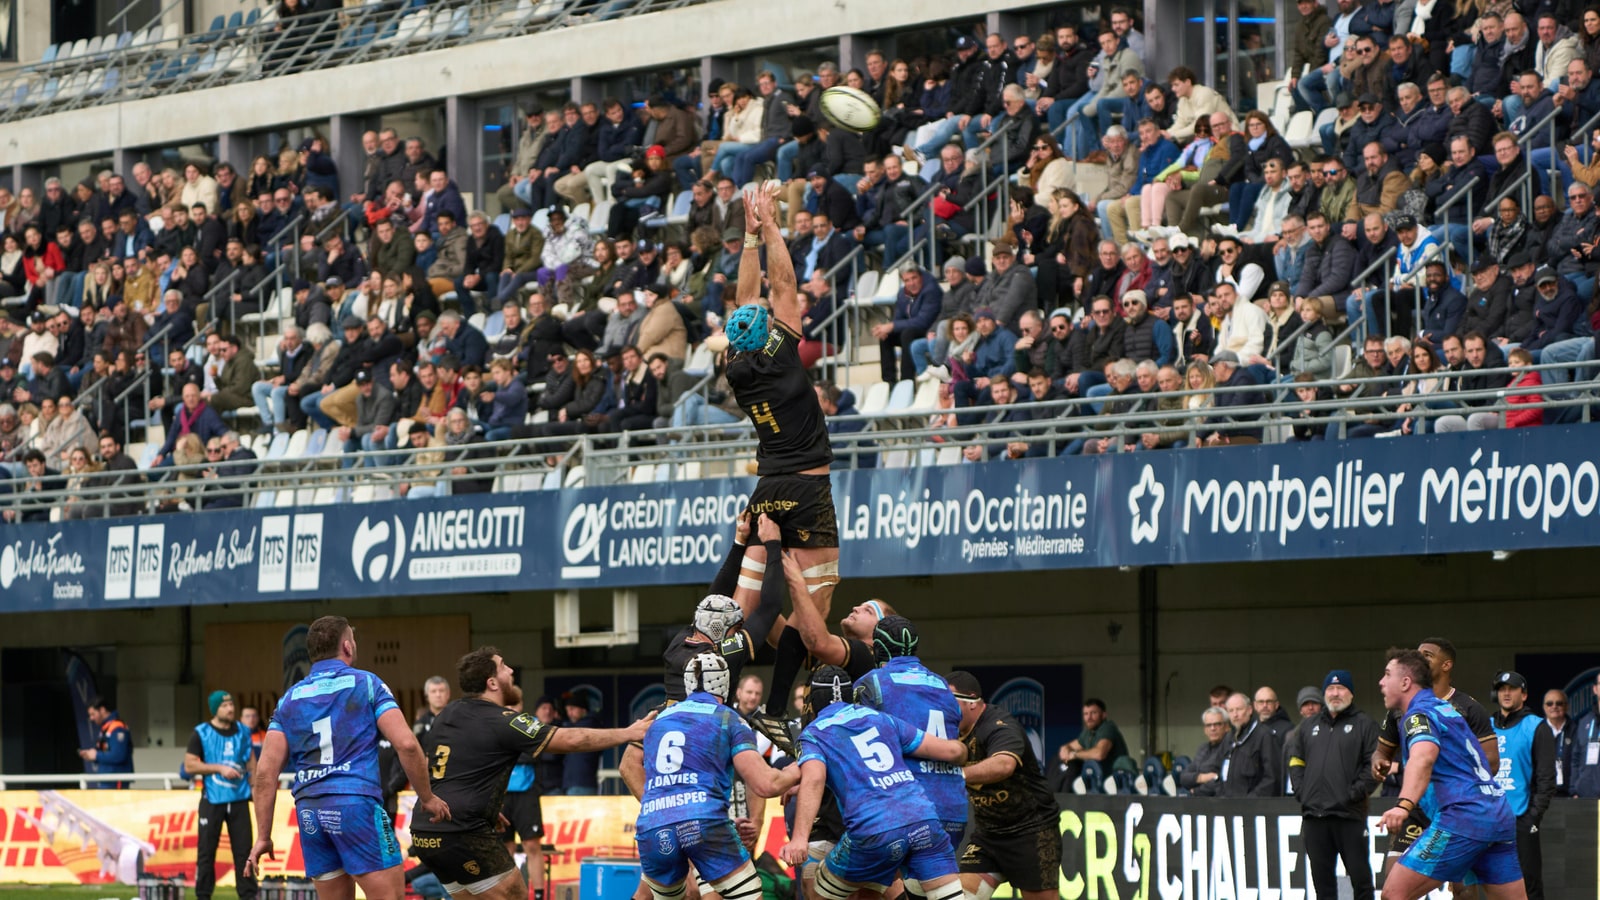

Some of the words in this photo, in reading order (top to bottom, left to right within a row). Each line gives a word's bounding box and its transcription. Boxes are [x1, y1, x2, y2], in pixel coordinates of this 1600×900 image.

[751, 401, 781, 434] 4
[610, 492, 676, 531] CRÉDIT
[842, 495, 870, 540] La
[875, 488, 961, 548] Région
[964, 480, 1087, 534] Occitanie
[1182, 458, 1405, 546] Montpellier
[410, 505, 526, 552] ANGELOTTI
[14, 540, 35, 581] Sud
[46, 531, 86, 581] France
[109, 545, 130, 575] RTS
[139, 543, 161, 573] RTS
[168, 538, 213, 589] Rythme
[213, 532, 226, 571] le
[227, 525, 257, 570] Sud
[263, 535, 285, 566] RTS
[295, 534, 319, 564] RTS
[608, 533, 723, 568] LANGUEDOC
[961, 538, 1009, 563] Pyrénées
[1015, 533, 1085, 556] Méditerranée
[412, 561, 452, 575] GROUPE
[456, 558, 518, 573] IMMOBILIER
[312, 715, 334, 765] 1
[656, 730, 687, 775] 6
[850, 726, 895, 772] 5
[430, 744, 452, 780] 3
[642, 791, 707, 816] COMMSPEC
